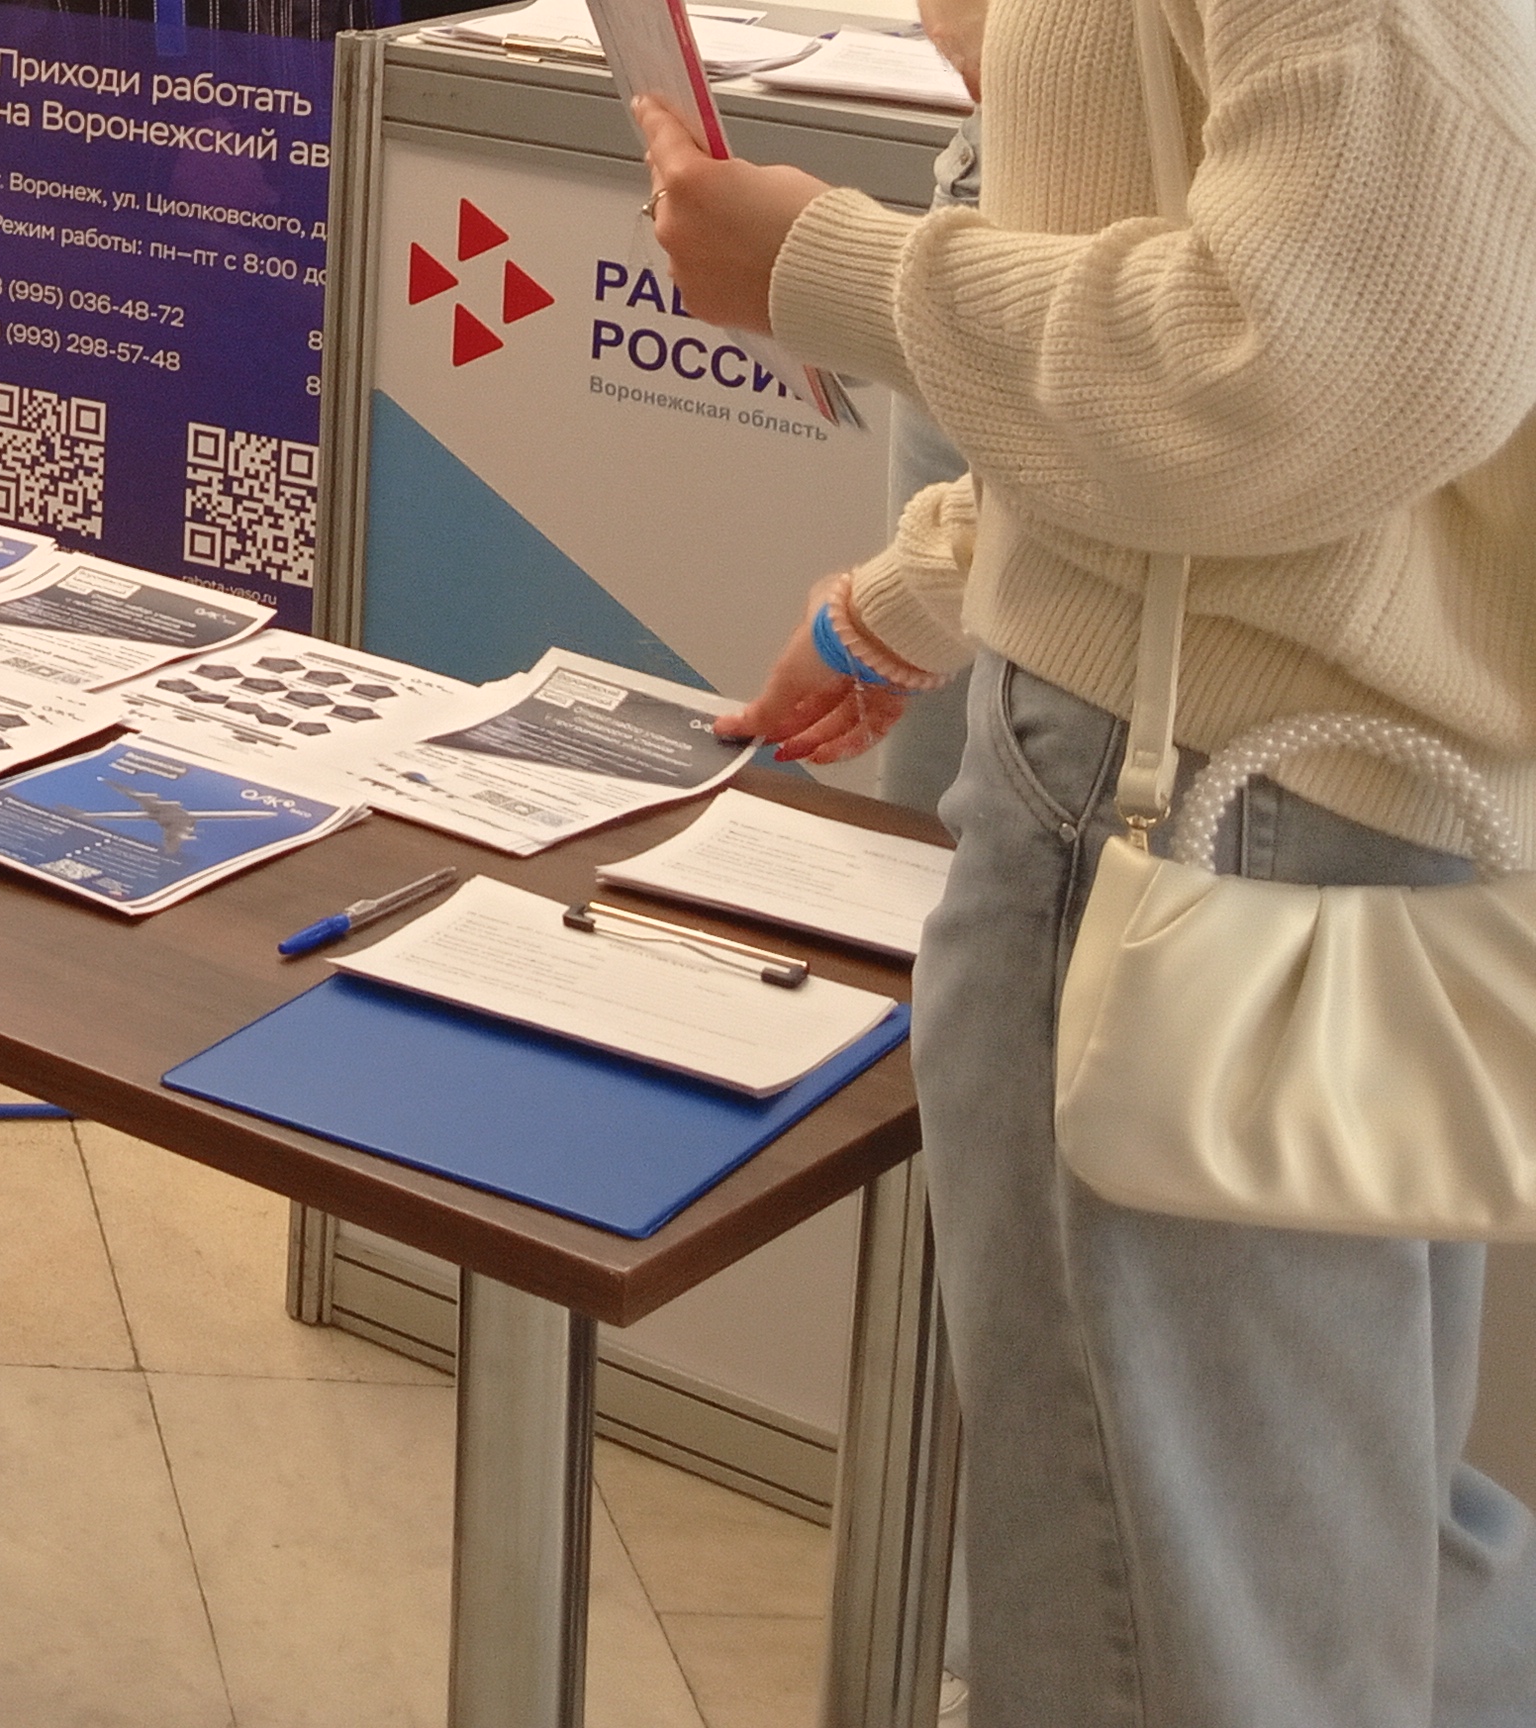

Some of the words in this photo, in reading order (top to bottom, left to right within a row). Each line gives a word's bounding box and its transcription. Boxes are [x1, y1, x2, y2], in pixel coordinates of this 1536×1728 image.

[152, 72, 312, 116] работать
[41, 100, 278, 161] Воронежский
[9, 172, 108, 208] Воронеж,
[112, 189, 141, 212] ул.
[145, 192, 307, 239] Циолковского,
[60, 228, 144, 256] работы:
[224, 254, 237, 271] с
[243, 253, 298, 280] 8:00
[8, 279, 64, 310] (995)
[69, 290, 185, 328] 036-48-72
[6, 322, 62, 354] (993)
[66, 333, 181, 372] 298-57-48
[308, 330, 324, 351] 8
[305, 375, 322, 396] 8
[589, 375, 731, 422] Воронежская
[738, 409, 828, 442] область
